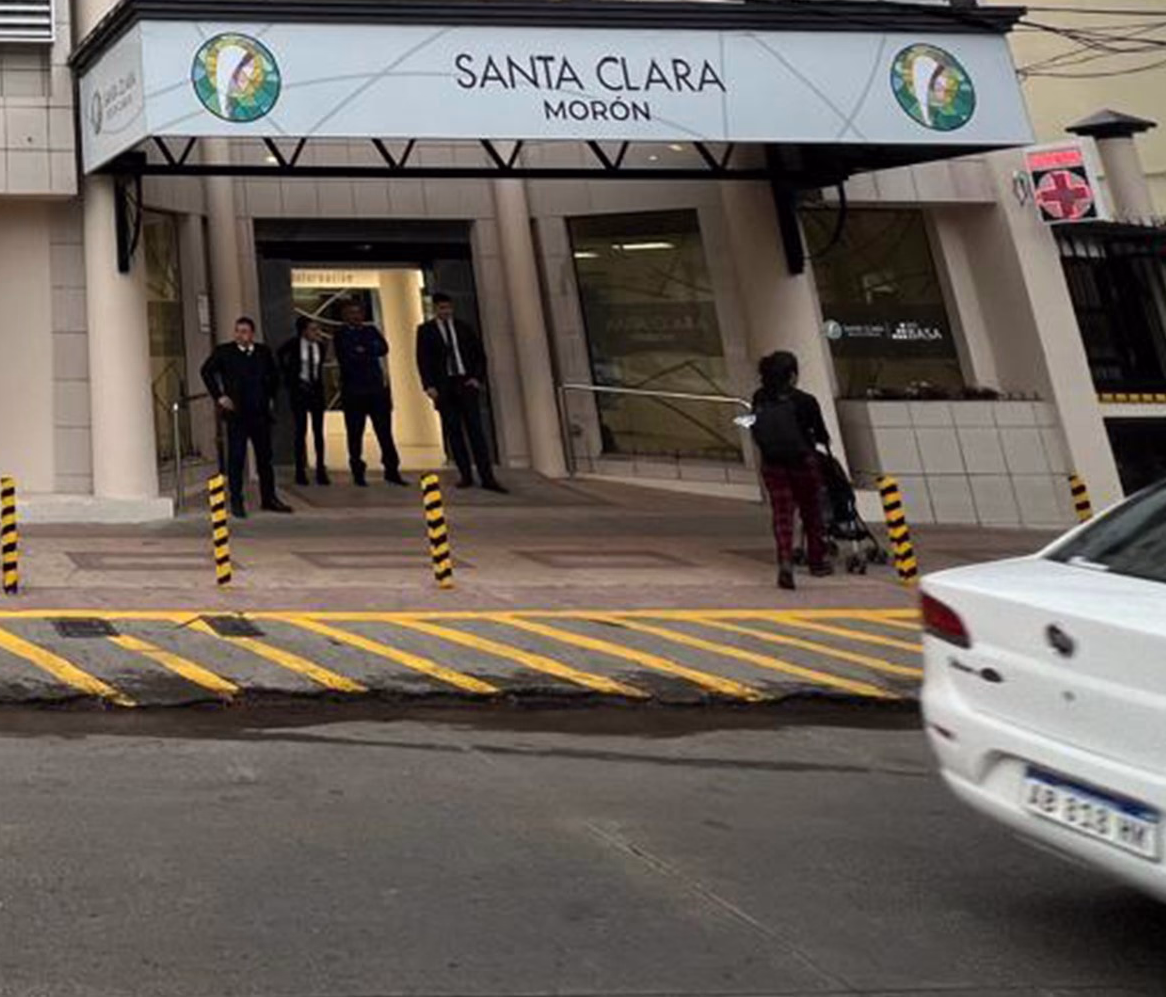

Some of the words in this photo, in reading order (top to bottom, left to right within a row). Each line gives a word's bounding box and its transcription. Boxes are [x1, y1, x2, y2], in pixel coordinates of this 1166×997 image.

[455, 53, 584, 90] SANTA
[596, 56, 726, 93] CLARA
[544, 96, 651, 121] MORÓN
